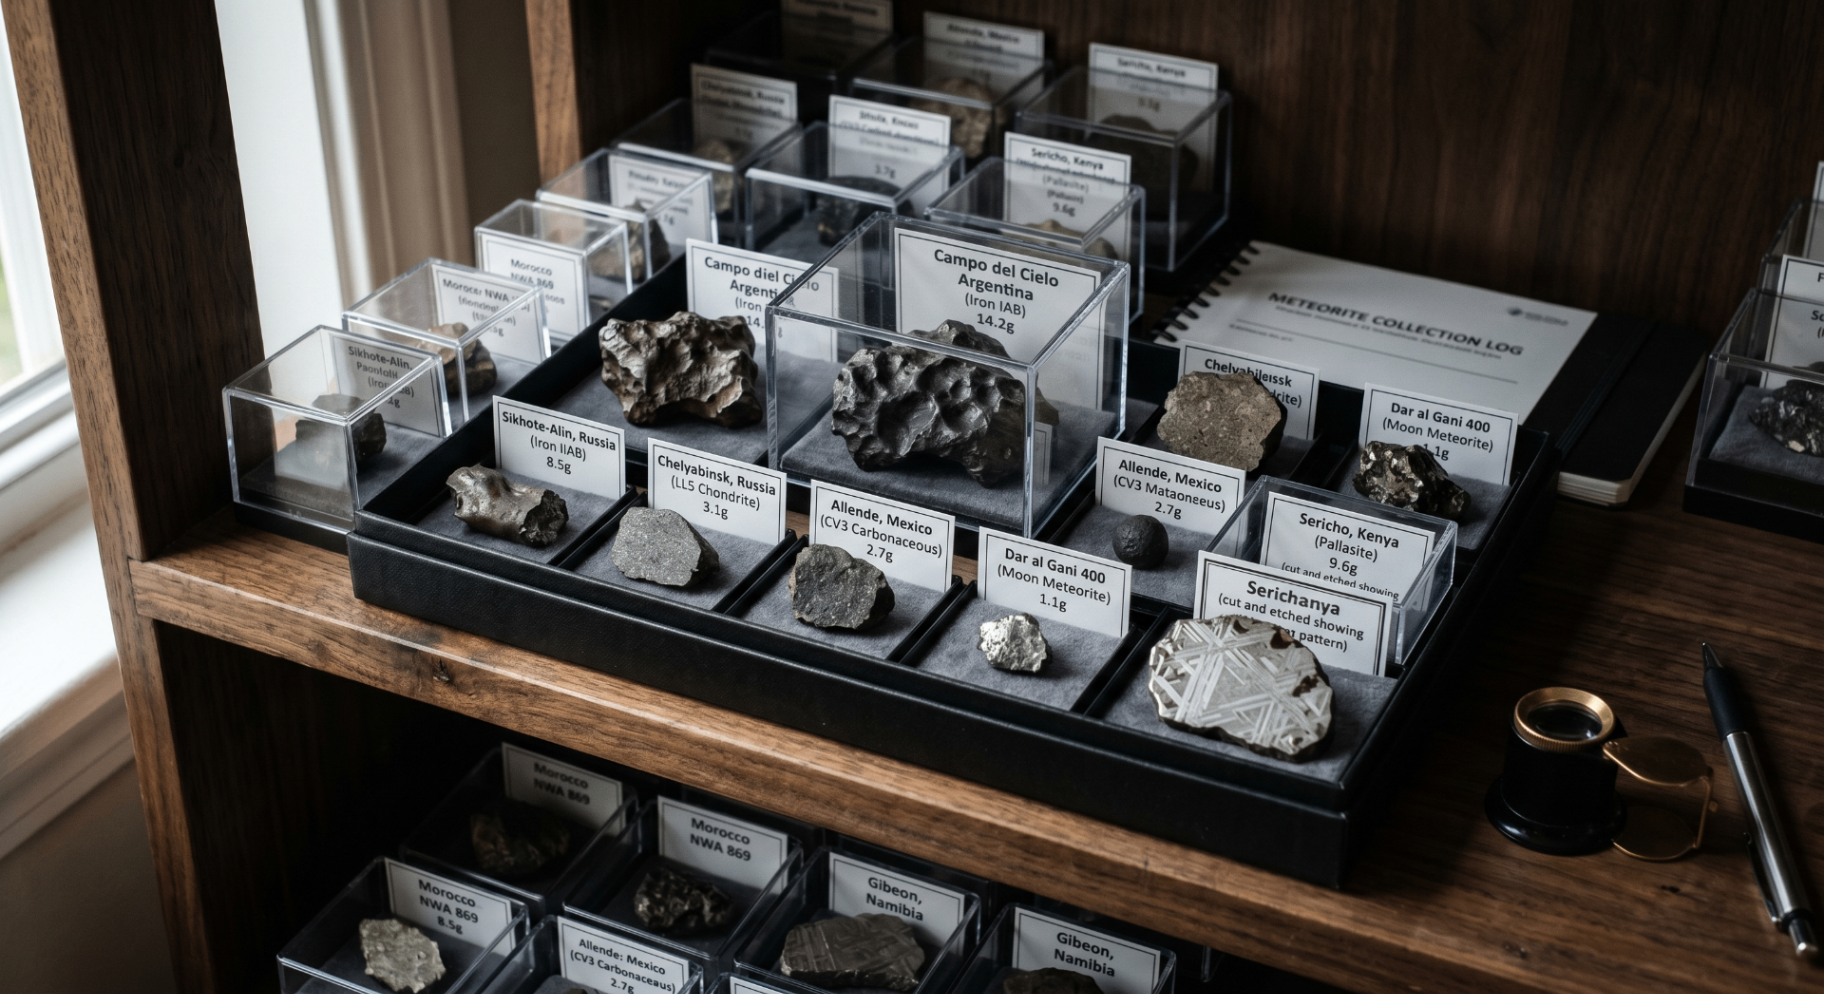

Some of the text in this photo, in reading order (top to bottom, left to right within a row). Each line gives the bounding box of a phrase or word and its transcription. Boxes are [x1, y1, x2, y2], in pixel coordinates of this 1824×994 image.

[1031, 148, 1103, 170] Sericho, Kenya
[1053, 202, 1076, 217] 9.6g
[511, 259, 552, 276] Morocco
[705, 256, 819, 291] Campo diel Cilo
[934, 249, 1059, 287] Campo del Cielo
[485, 289, 509, 302] NWA
[958, 273, 1034, 301] Argentina
[735, 297, 762, 312] (Iron
[965, 292, 1026, 319] (Iron IAB)
[977, 313, 1015, 334] 14.2g
[1268, 292, 1369, 322] METEORITE
[1372, 315, 1482, 347] COLLECTION
[1486, 340, 1524, 356] LOG
[502, 411, 616, 450] Sikhote-Alin, Russia
[1391, 402, 1490, 433] Dar al Gani 400
[530, 435, 586, 462] (Iron IIAB)
[1383, 417, 1493, 453] (Moon Meteorite)
[547, 456, 571, 475] 8.5g
[658, 455, 776, 495] Chelyabinsk, Russia
[1119, 460, 1222, 493] Allende, Mexico
[671, 475, 760, 511] (LL5 Chondrite)
[1114, 474, 1142, 491] (CV3
[703, 501, 728, 520] 3.1g
[831, 499, 933, 535] Allende, Mexico
[1155, 502, 1182, 520] 2.7g
[821, 514, 942, 558] (CV3 Carbonaceous)
[1299, 513, 1399, 549] Sericho, Kenya
[866, 544, 893, 563] 2.7g
[1314, 535, 1378, 563] (Pallasite)
[1005, 548, 1105, 583] Dar al Gani 400
[1329, 557, 1358, 577] 9.6g
[998, 564, 1111, 606] (Moon Meteorite)
[1282, 562, 1399, 601] (cut and etched showing
[1040, 594, 1067, 613] 1.1g
[1247, 580, 1341, 617] Serichanya
[1218, 592, 1242, 609] (cut
[1244, 602, 1266, 614] and
[1270, 606, 1311, 625] etched
[1314, 616, 1364, 641] showing
[1299, 631, 1348, 652] pattern)
[534, 762, 588, 789] Morocco
[534, 778, 565, 797] NWA
[691, 818, 750, 845] Morocco
[690, 833, 751, 862] NWA 869
[418, 879, 476, 907] Morocco
[868, 877, 922, 905] Gibeon,
[420, 895, 478, 924] NWA 869
[866, 893, 923, 921] Namibia
[570, 950, 594, 965] (CV3
[579, 939, 666, 975] Allende: Mexico
[1057, 932, 1114, 960] Gibeon,
[1054, 949, 1115, 977] Namibia
[610, 978, 634, 994] 2.7g
